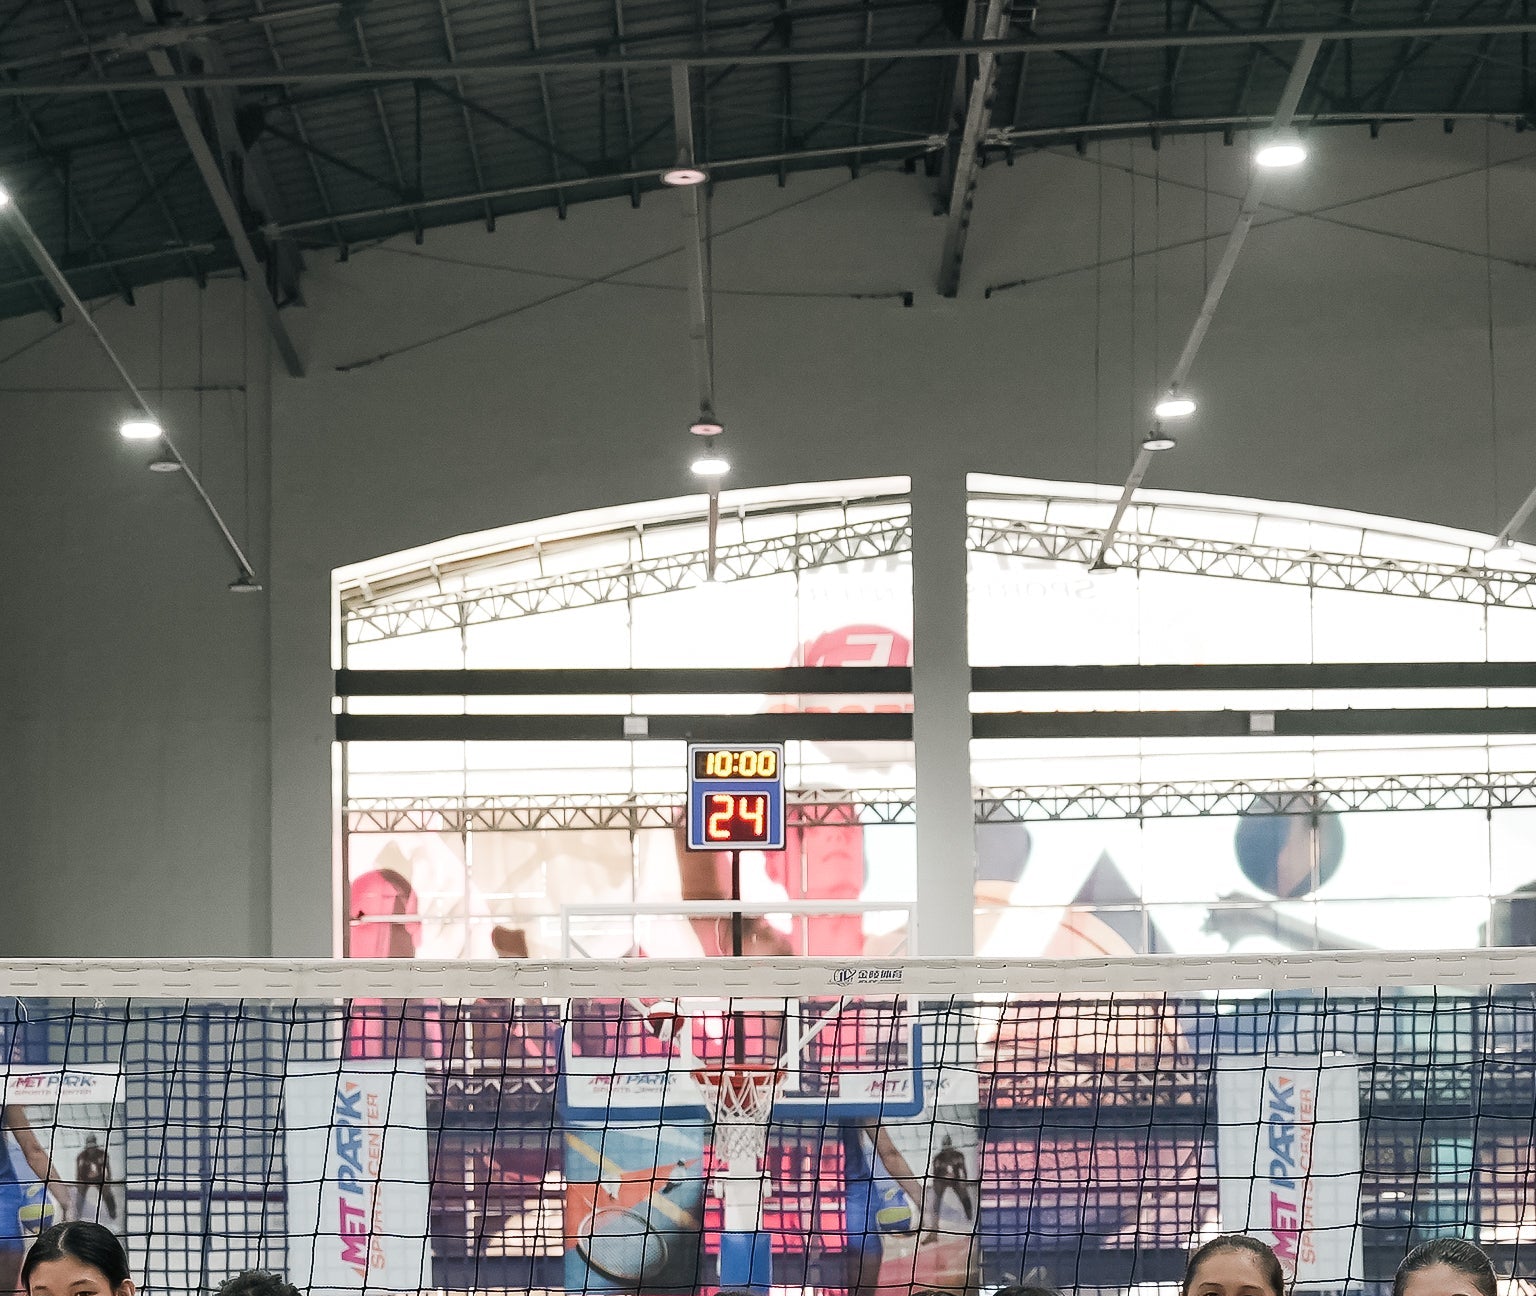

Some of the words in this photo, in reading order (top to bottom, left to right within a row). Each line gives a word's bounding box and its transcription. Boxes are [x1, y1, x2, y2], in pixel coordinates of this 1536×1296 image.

[706, 750, 776, 777] 10:00
[708, 795, 766, 839] 24
[16, 1076, 46, 1088] MET
[337, 1090, 364, 1194] PARK
[1268, 1080, 1295, 1189] PARK
[340, 1196, 366, 1266] MET
[1270, 1191, 1296, 1260] MET
